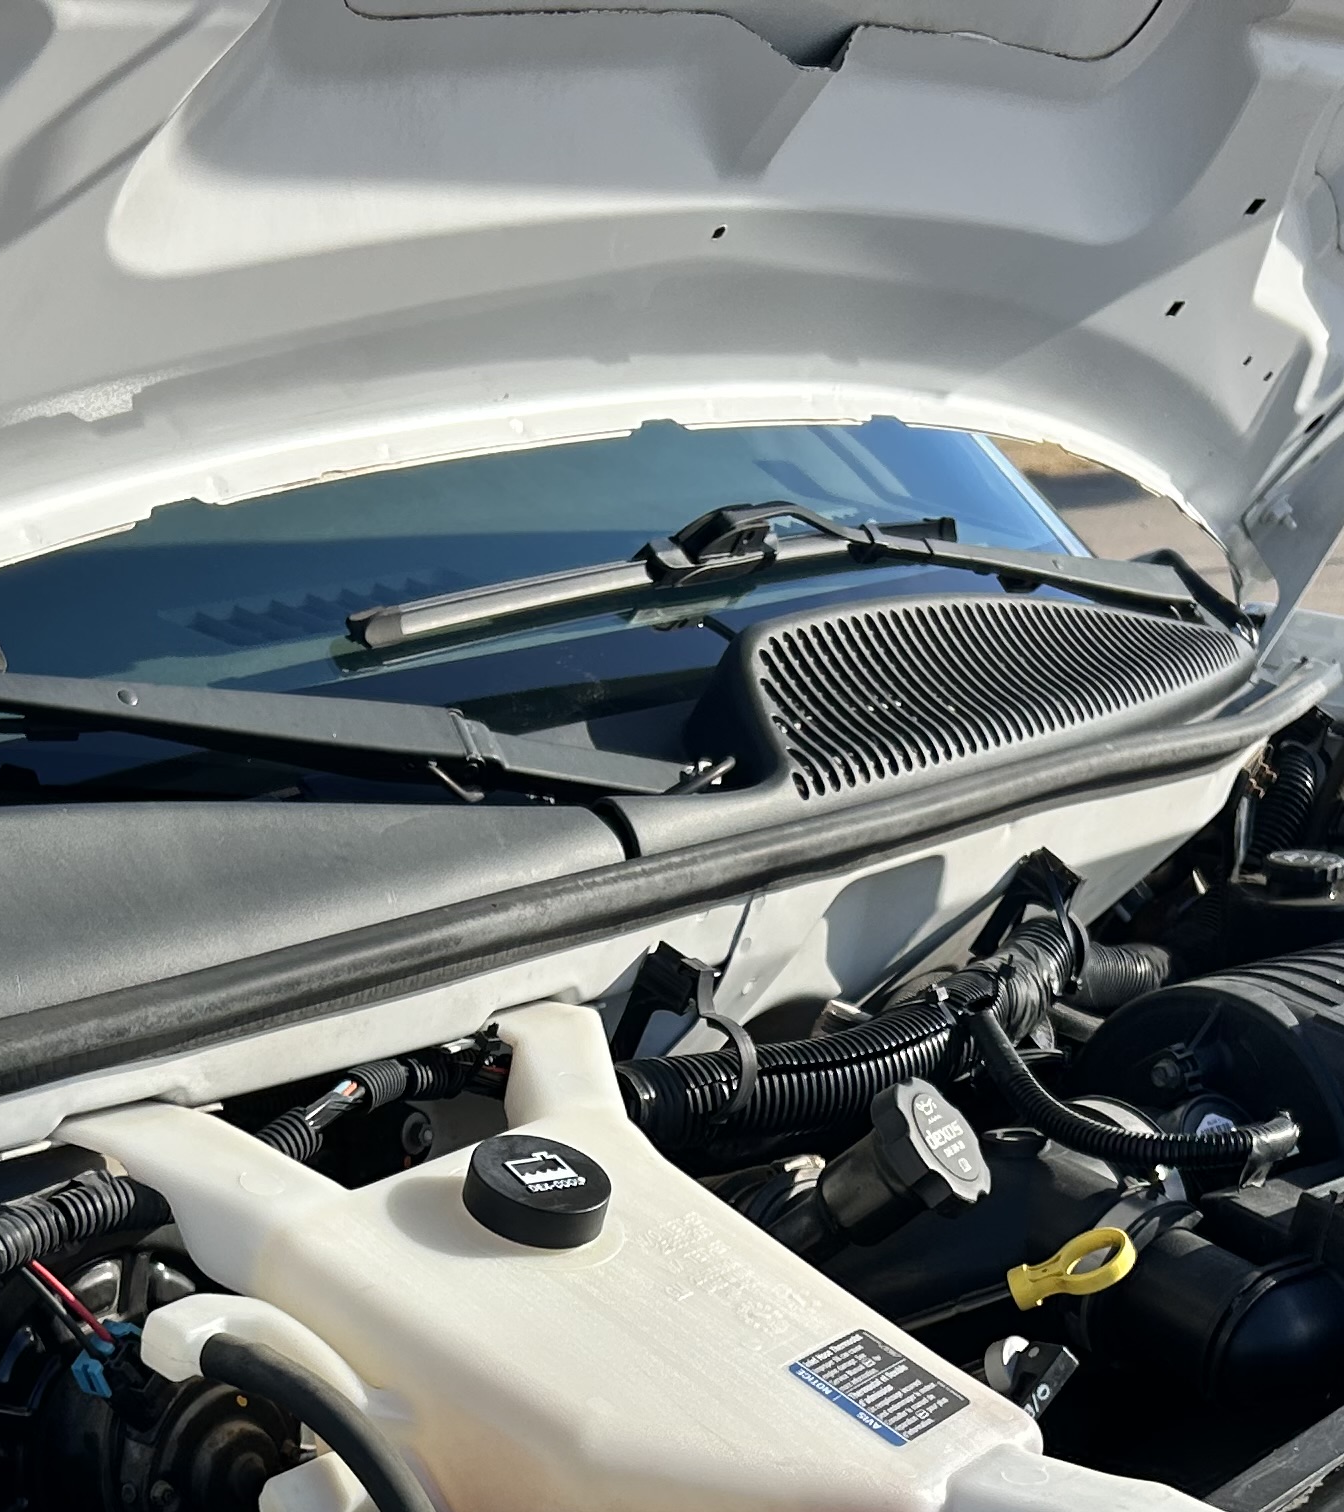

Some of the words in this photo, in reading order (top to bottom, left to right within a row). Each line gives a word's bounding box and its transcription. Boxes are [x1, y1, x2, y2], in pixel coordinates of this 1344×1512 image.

[925, 1119, 964, 1150] dexos
[796, 1368, 833, 1395] NOTICE
[856, 1411, 883, 1430] AVIS
